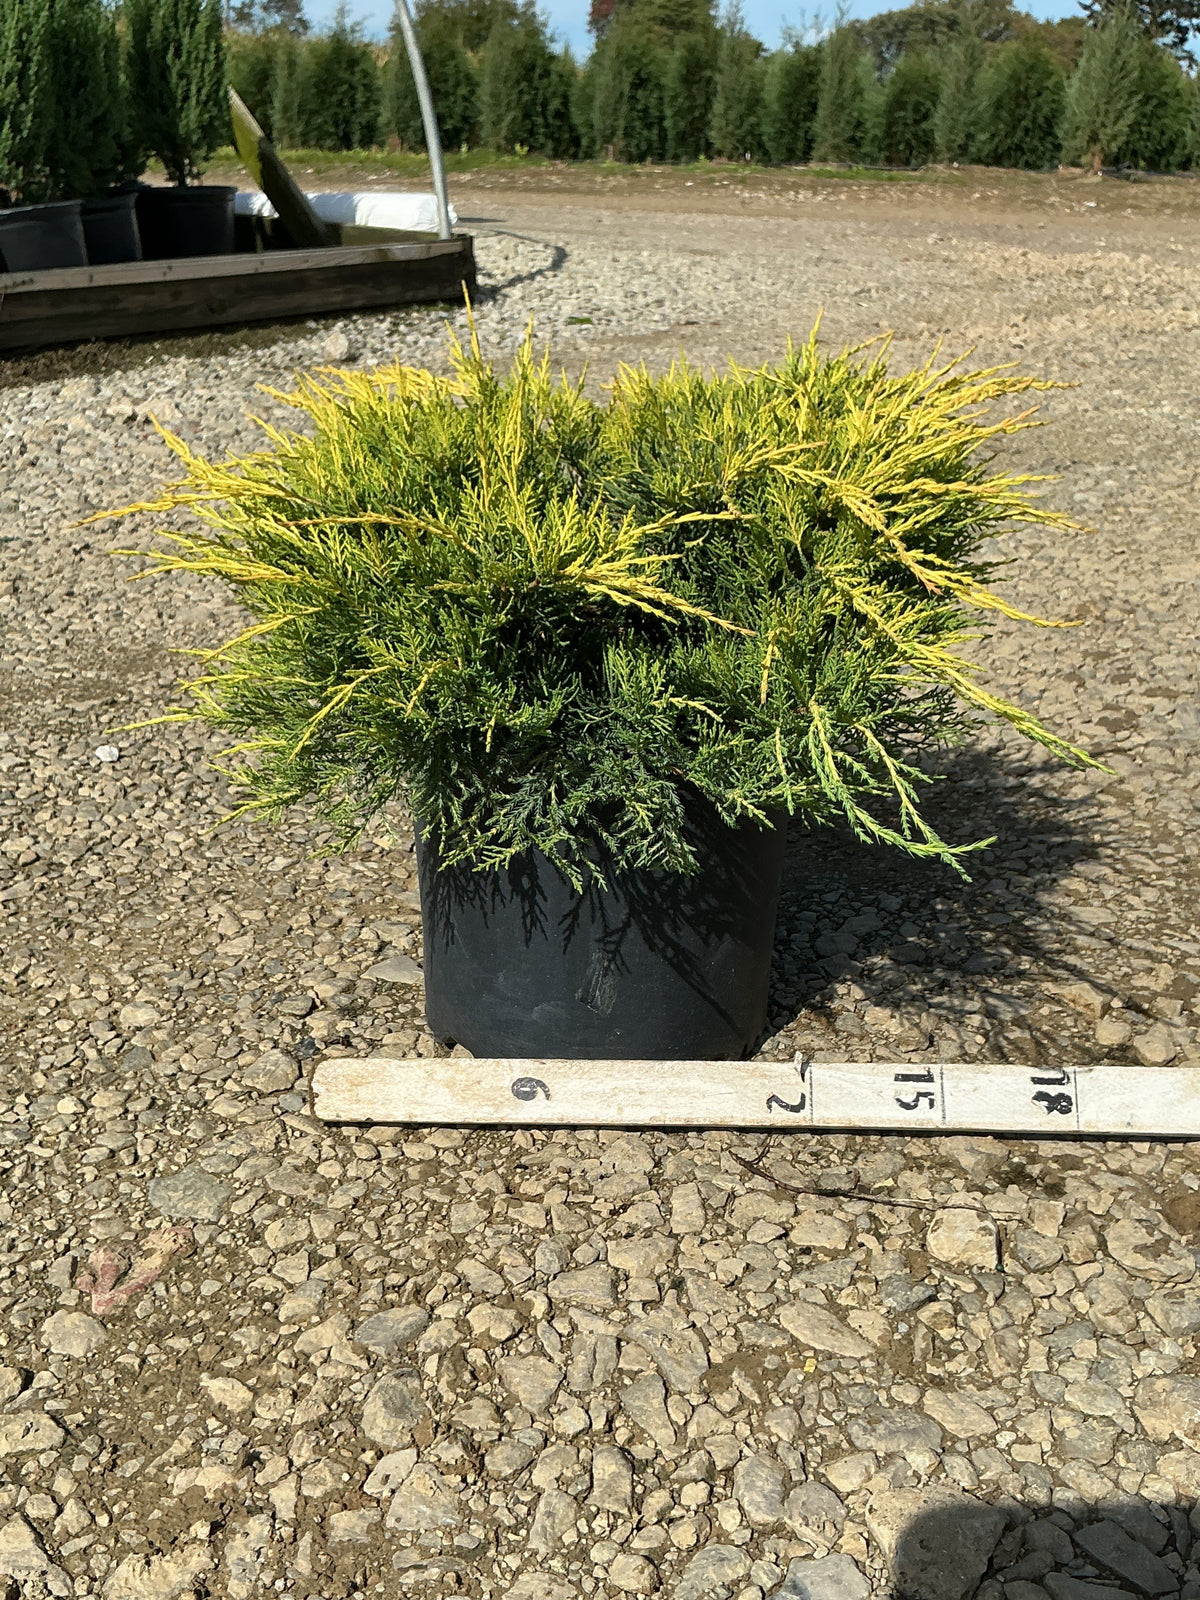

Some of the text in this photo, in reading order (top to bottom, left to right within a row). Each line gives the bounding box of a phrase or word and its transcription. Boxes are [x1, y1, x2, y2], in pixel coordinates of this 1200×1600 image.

[511, 1077, 550, 1101] 6
[893, 1067, 935, 1110] 15
[1030, 1070, 1073, 1115] 18
